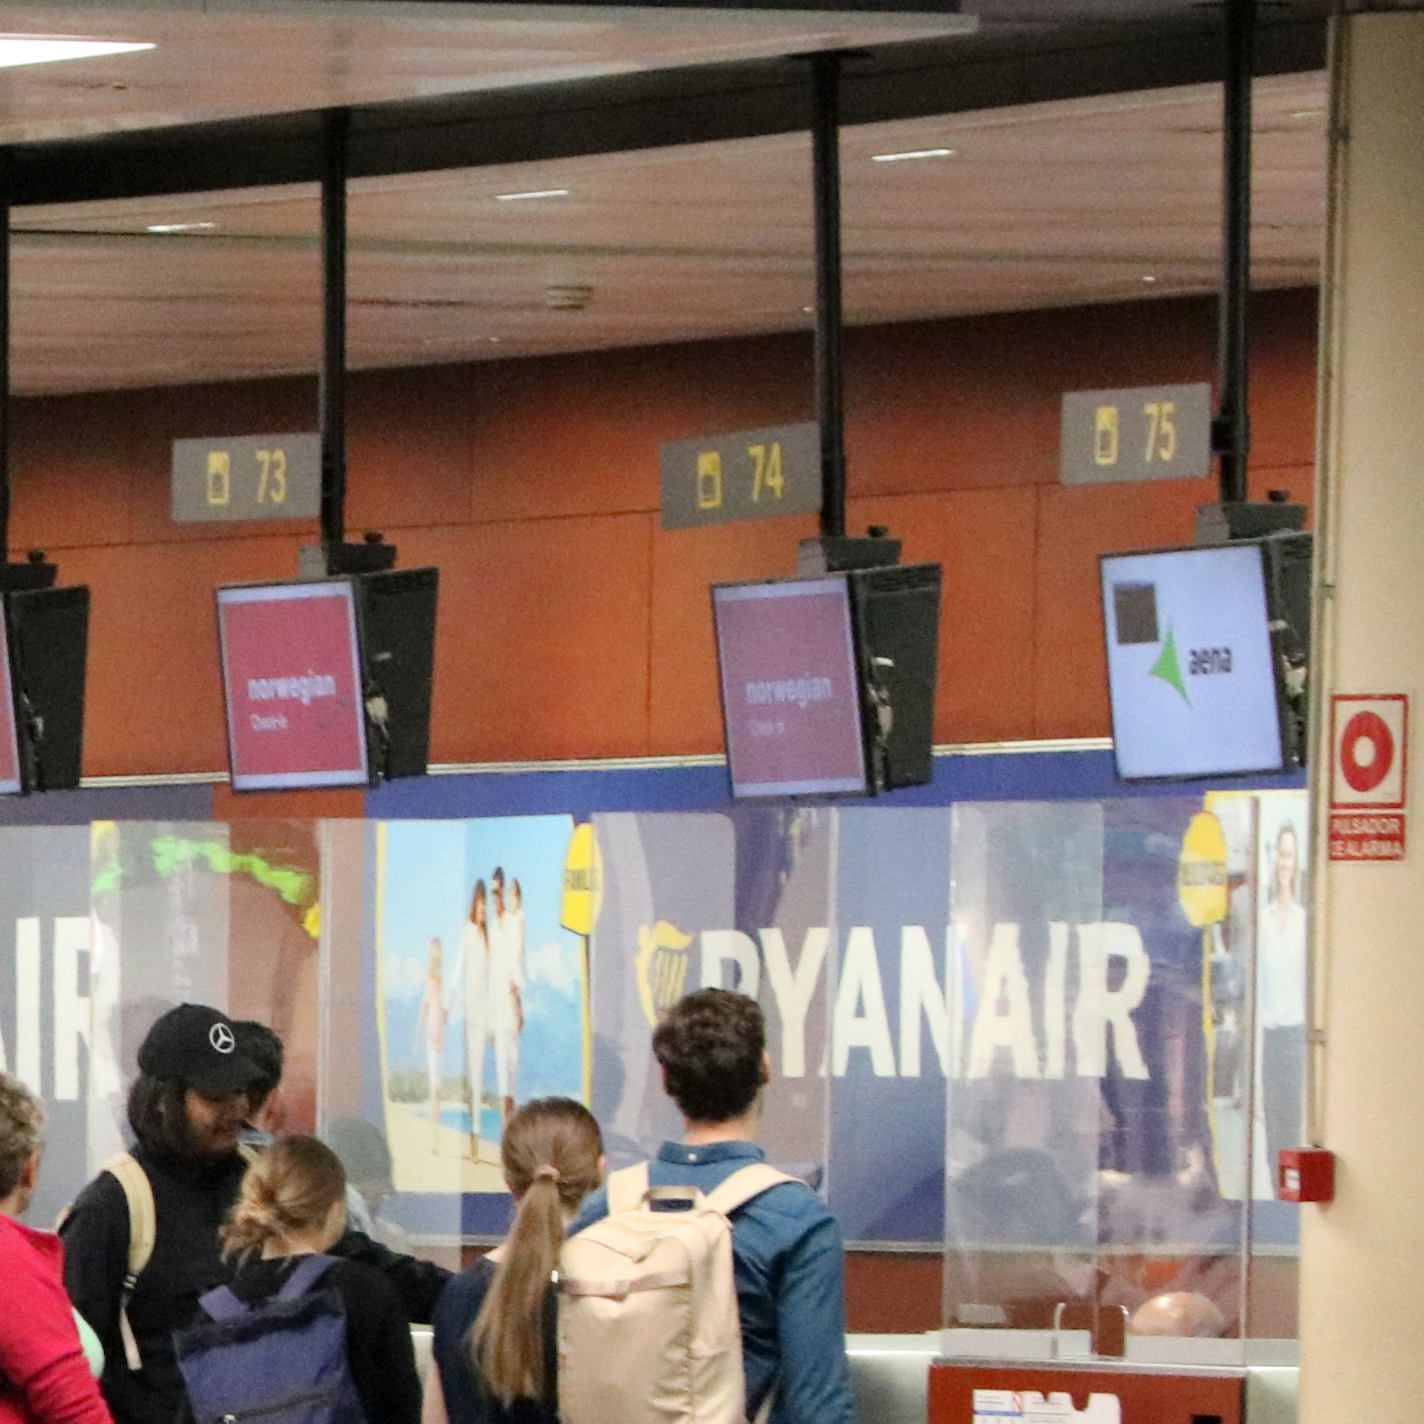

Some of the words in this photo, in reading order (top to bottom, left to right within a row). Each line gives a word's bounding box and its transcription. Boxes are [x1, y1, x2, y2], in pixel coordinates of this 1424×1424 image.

[1144, 401, 1175, 462] 75
[256, 449, 288, 504] 73
[748, 442, 784, 503] 74
[1189, 647, 1232, 675] aena
[248, 669, 336, 705] norwegian
[746, 672, 833, 708] norwegian
